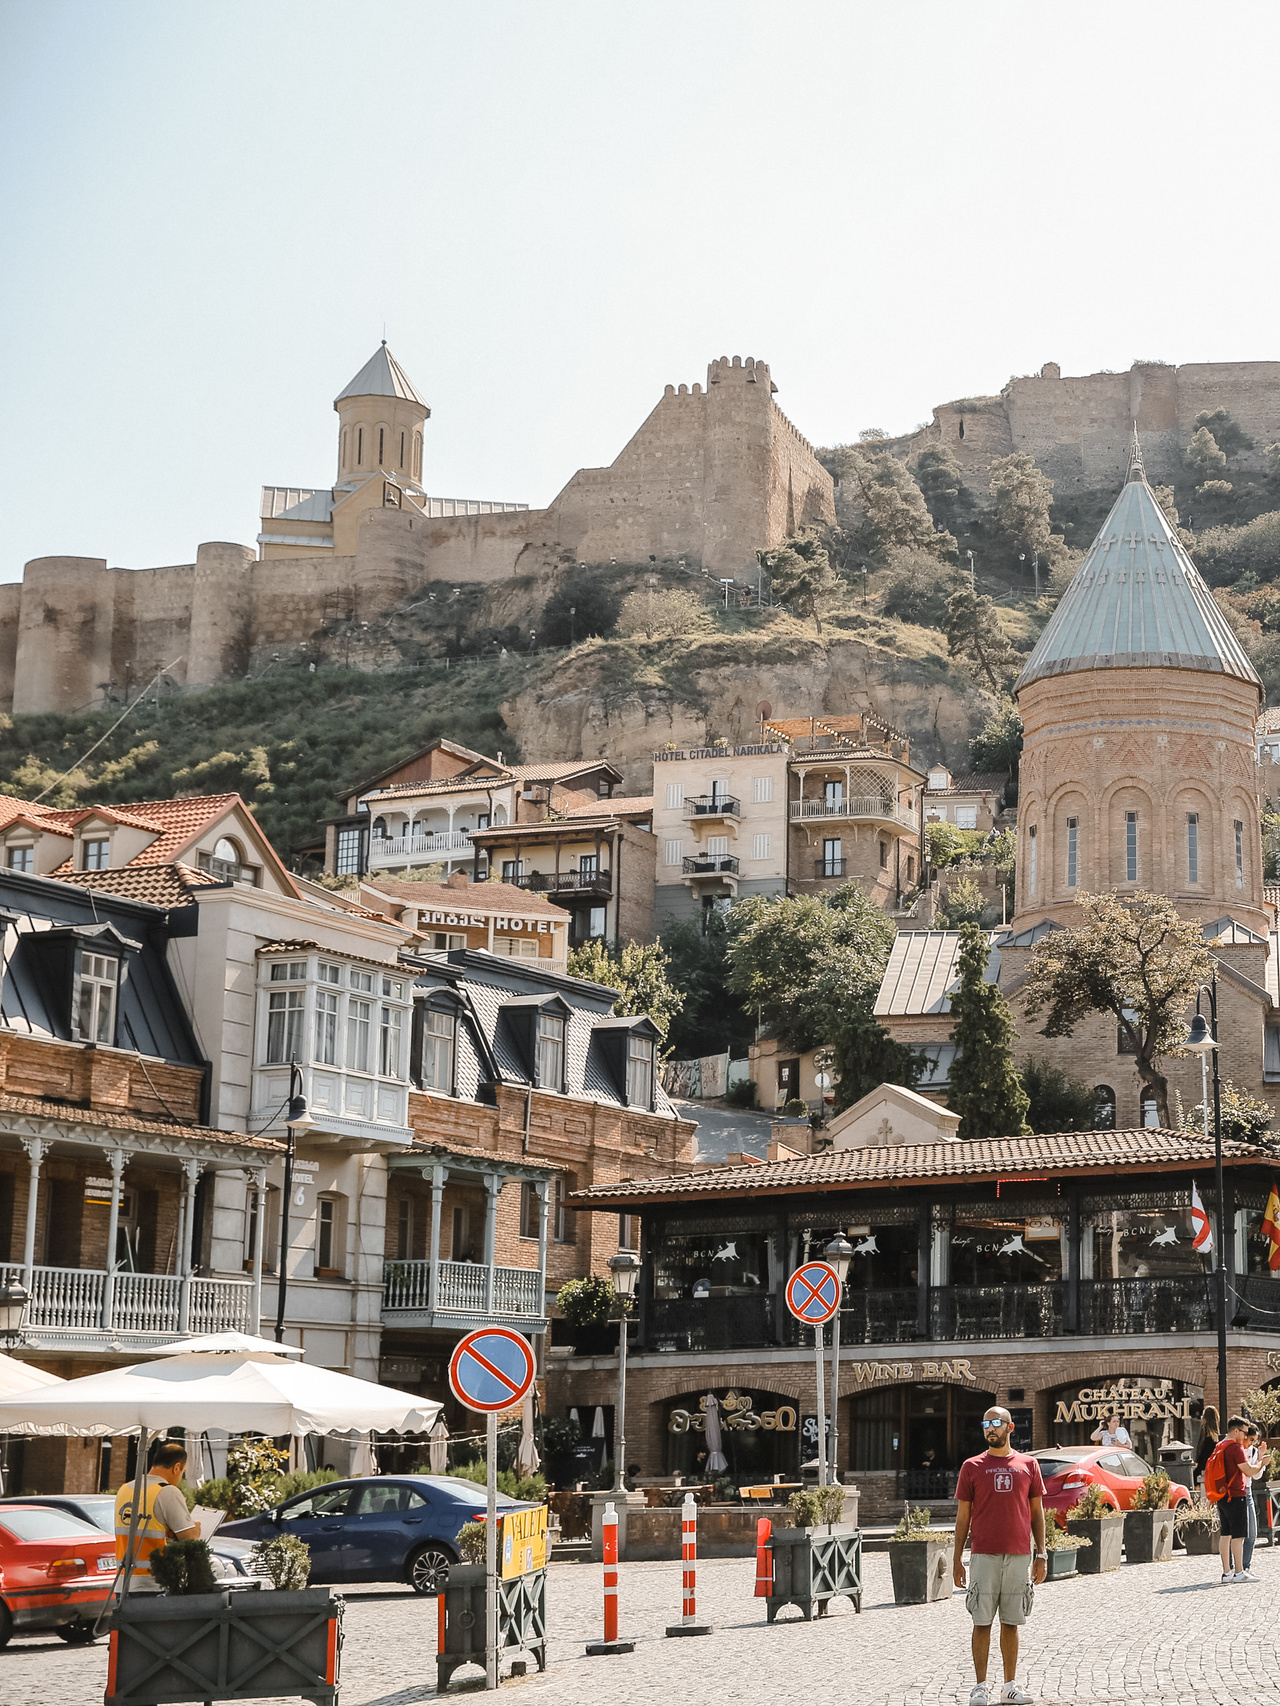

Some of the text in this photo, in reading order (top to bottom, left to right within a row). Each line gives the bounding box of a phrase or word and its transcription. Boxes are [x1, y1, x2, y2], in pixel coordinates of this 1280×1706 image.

[654, 744, 783, 762] HOTEL CITADEL NARIKALA
[496, 917, 560, 934] HOTEL
[293, 1186, 305, 1206] 6
[852, 1359, 976, 1383] WINE BAR
[1078, 1384, 1168, 1403] CHÂTEAU
[1054, 1397, 1192, 1424] MUKHRANI
[511, 1508, 544, 1542] VALET
